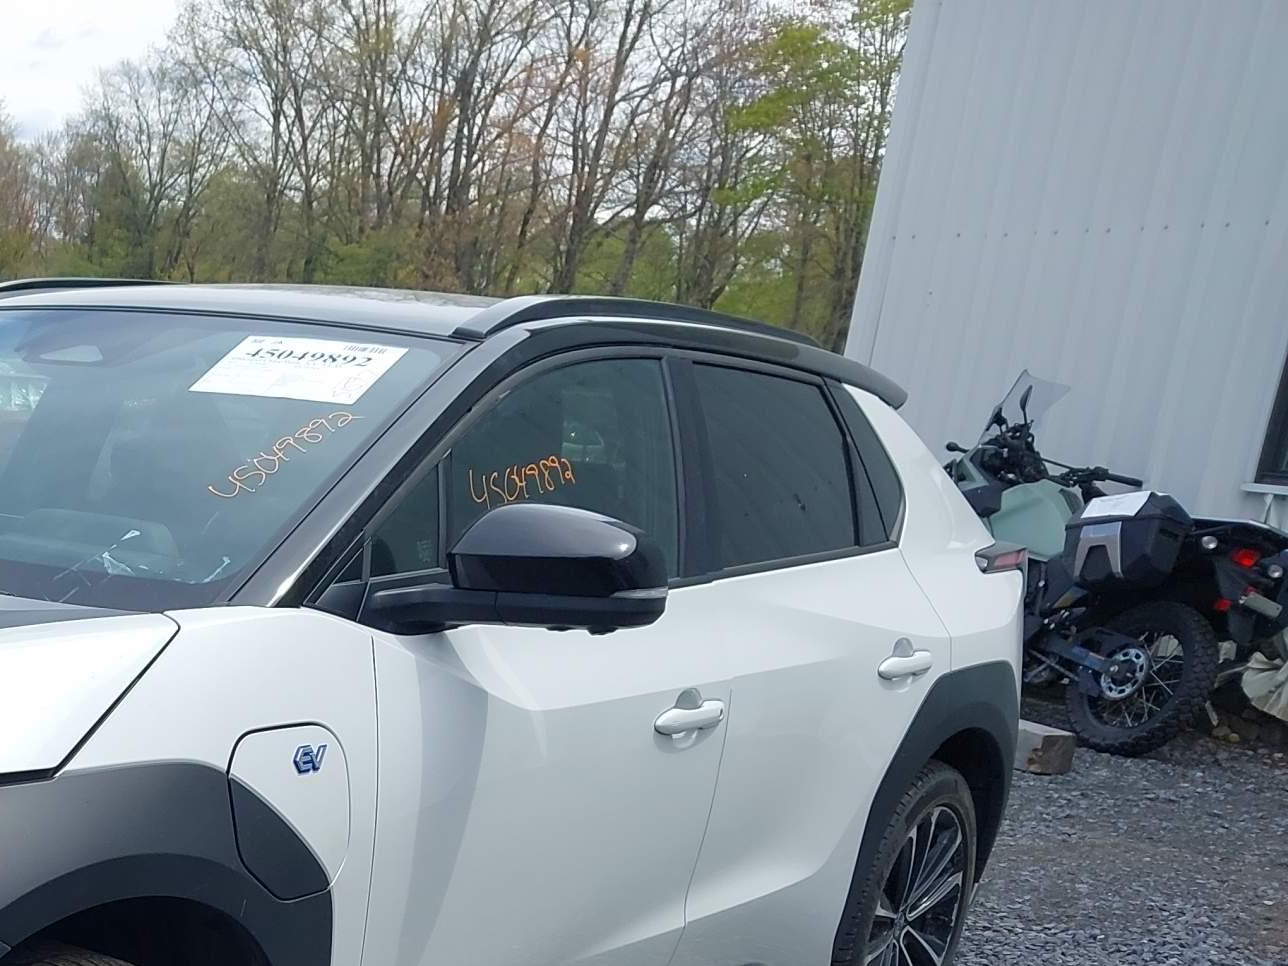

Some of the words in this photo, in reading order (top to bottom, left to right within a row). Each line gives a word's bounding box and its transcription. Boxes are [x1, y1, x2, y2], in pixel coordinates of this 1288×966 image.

[245, 347, 372, 367] 45049892
[207, 411, 366, 498] 45049892
[469, 455, 576, 511] 45049892
[292, 744, 328, 774] EV
